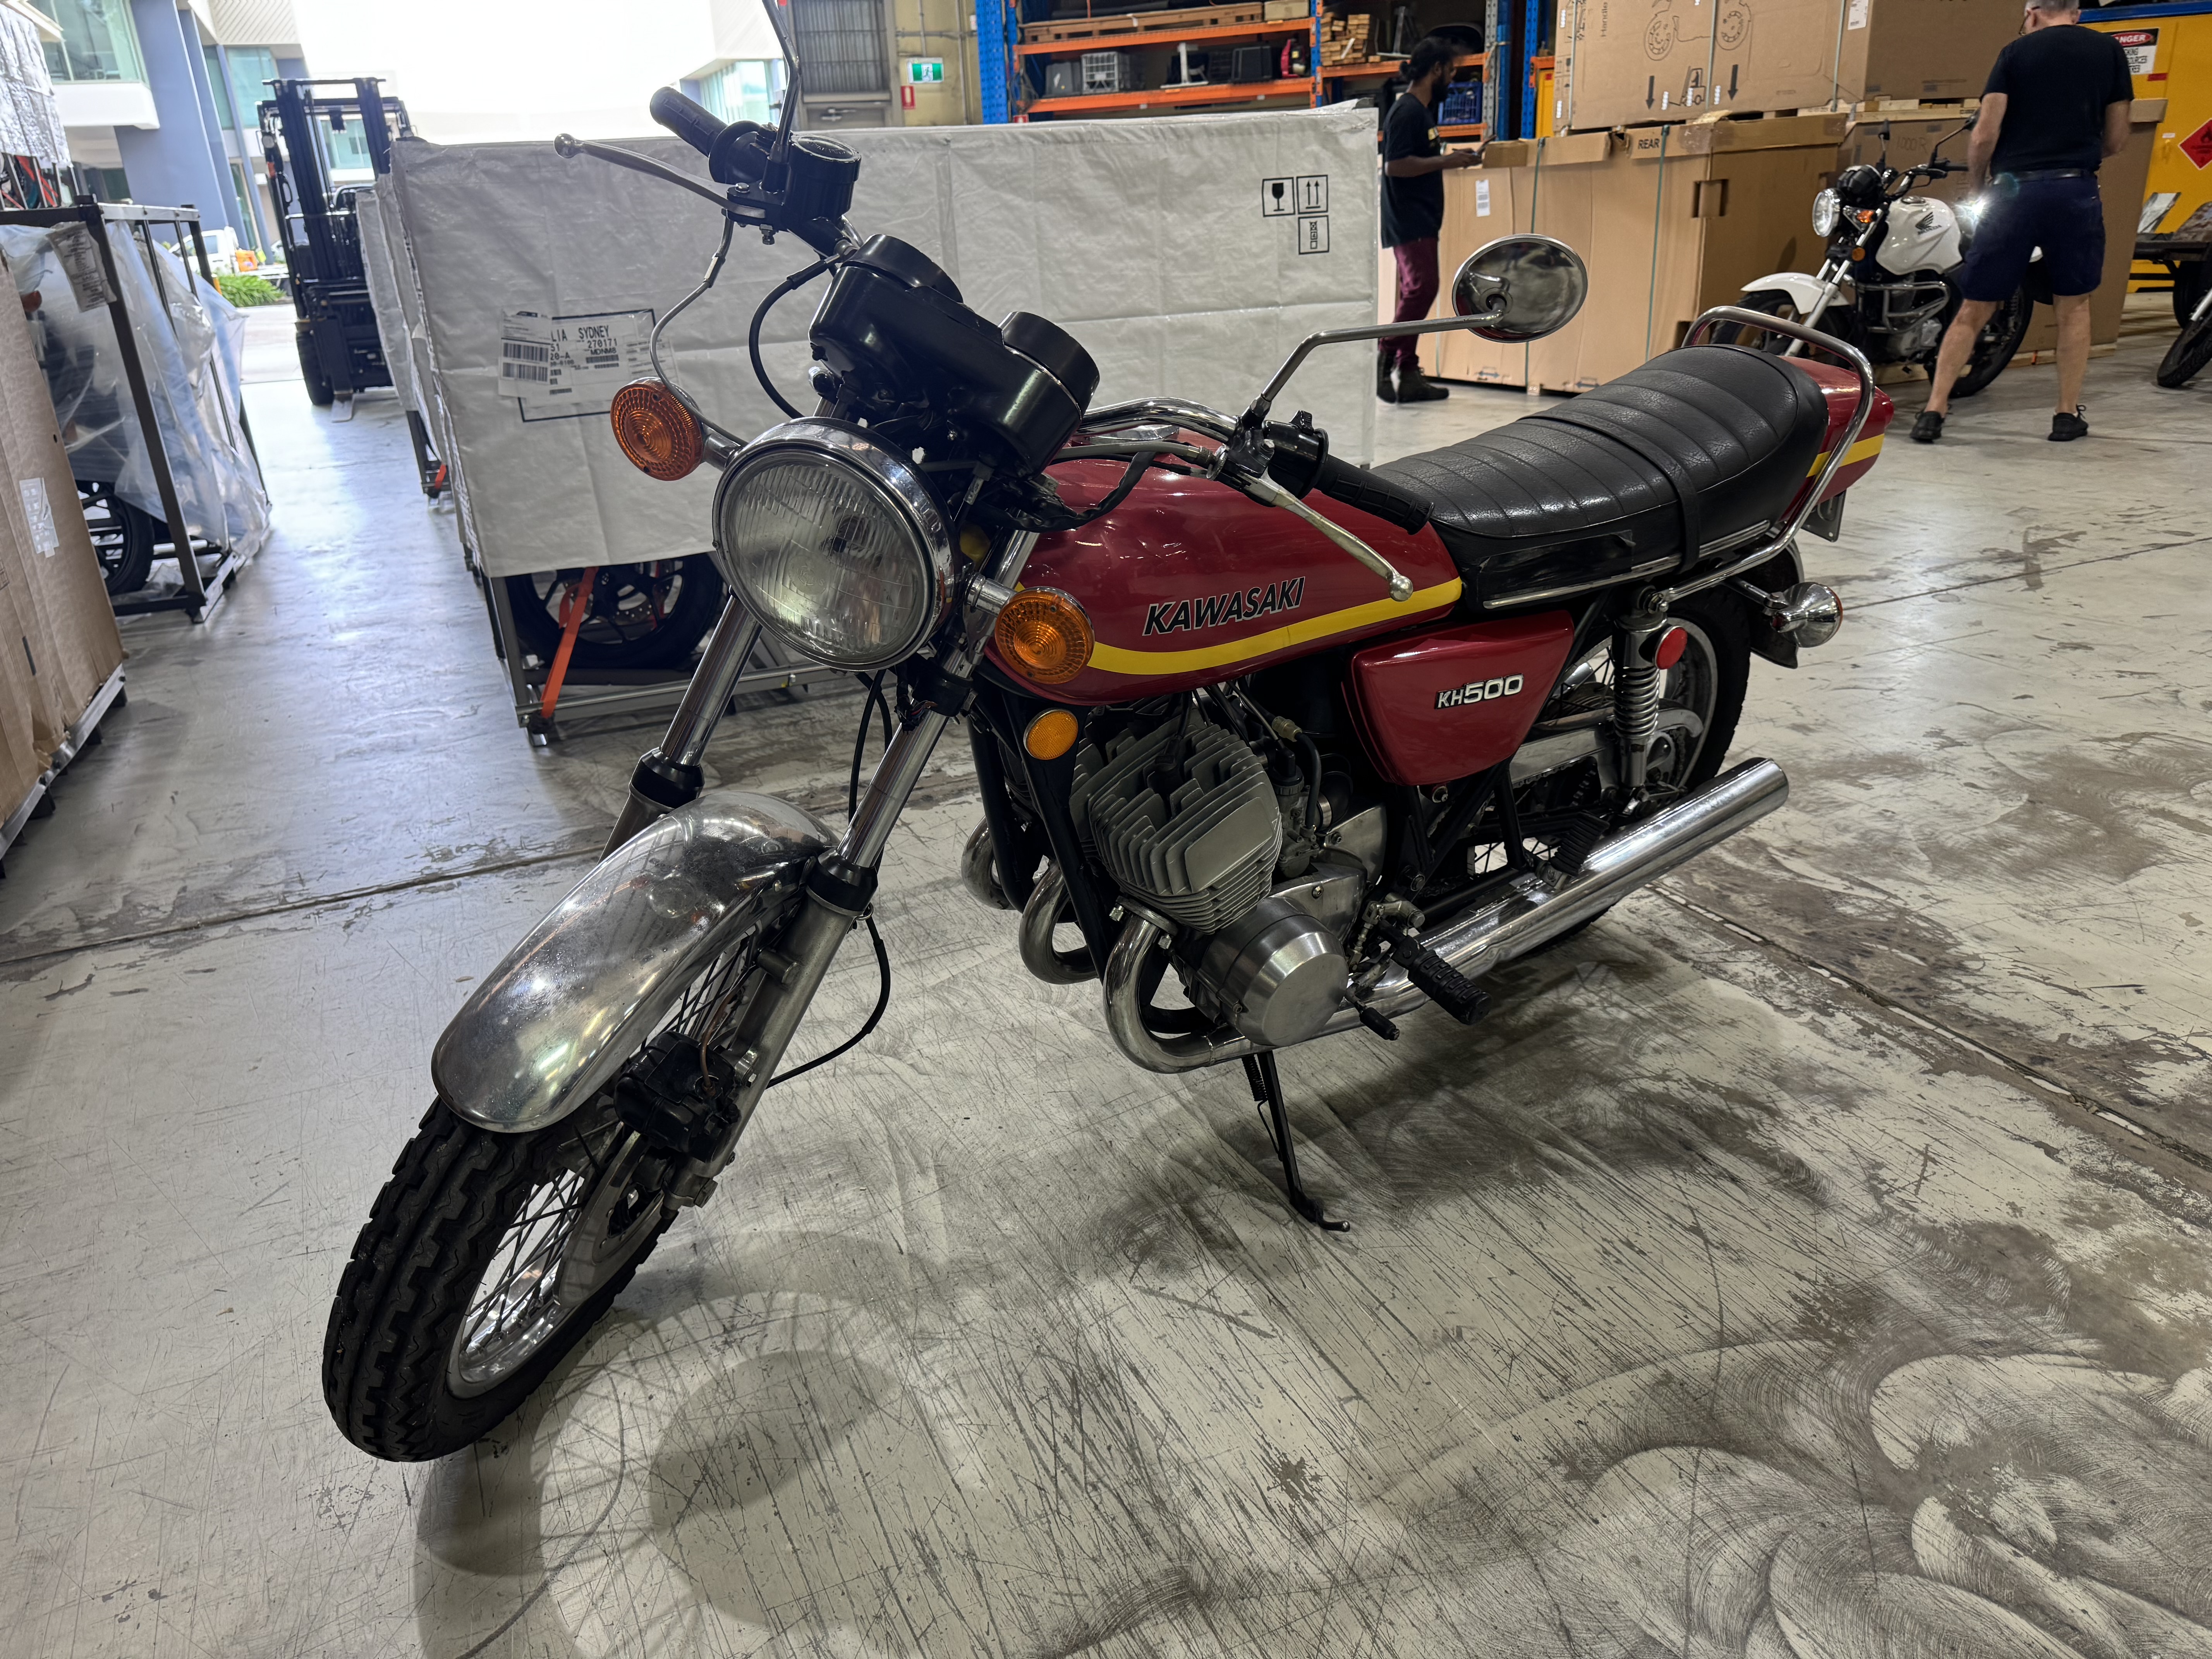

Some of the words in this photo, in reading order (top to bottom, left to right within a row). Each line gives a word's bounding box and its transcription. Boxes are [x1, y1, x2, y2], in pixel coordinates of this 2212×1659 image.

[2115, 34, 2146, 43] NGER
[1638, 138, 1660, 149] REAR
[578, 325, 609, 339] SYDNEY
[1142, 576, 1305, 636] KAWASAKI
[1437, 674, 1524, 708] KH500
